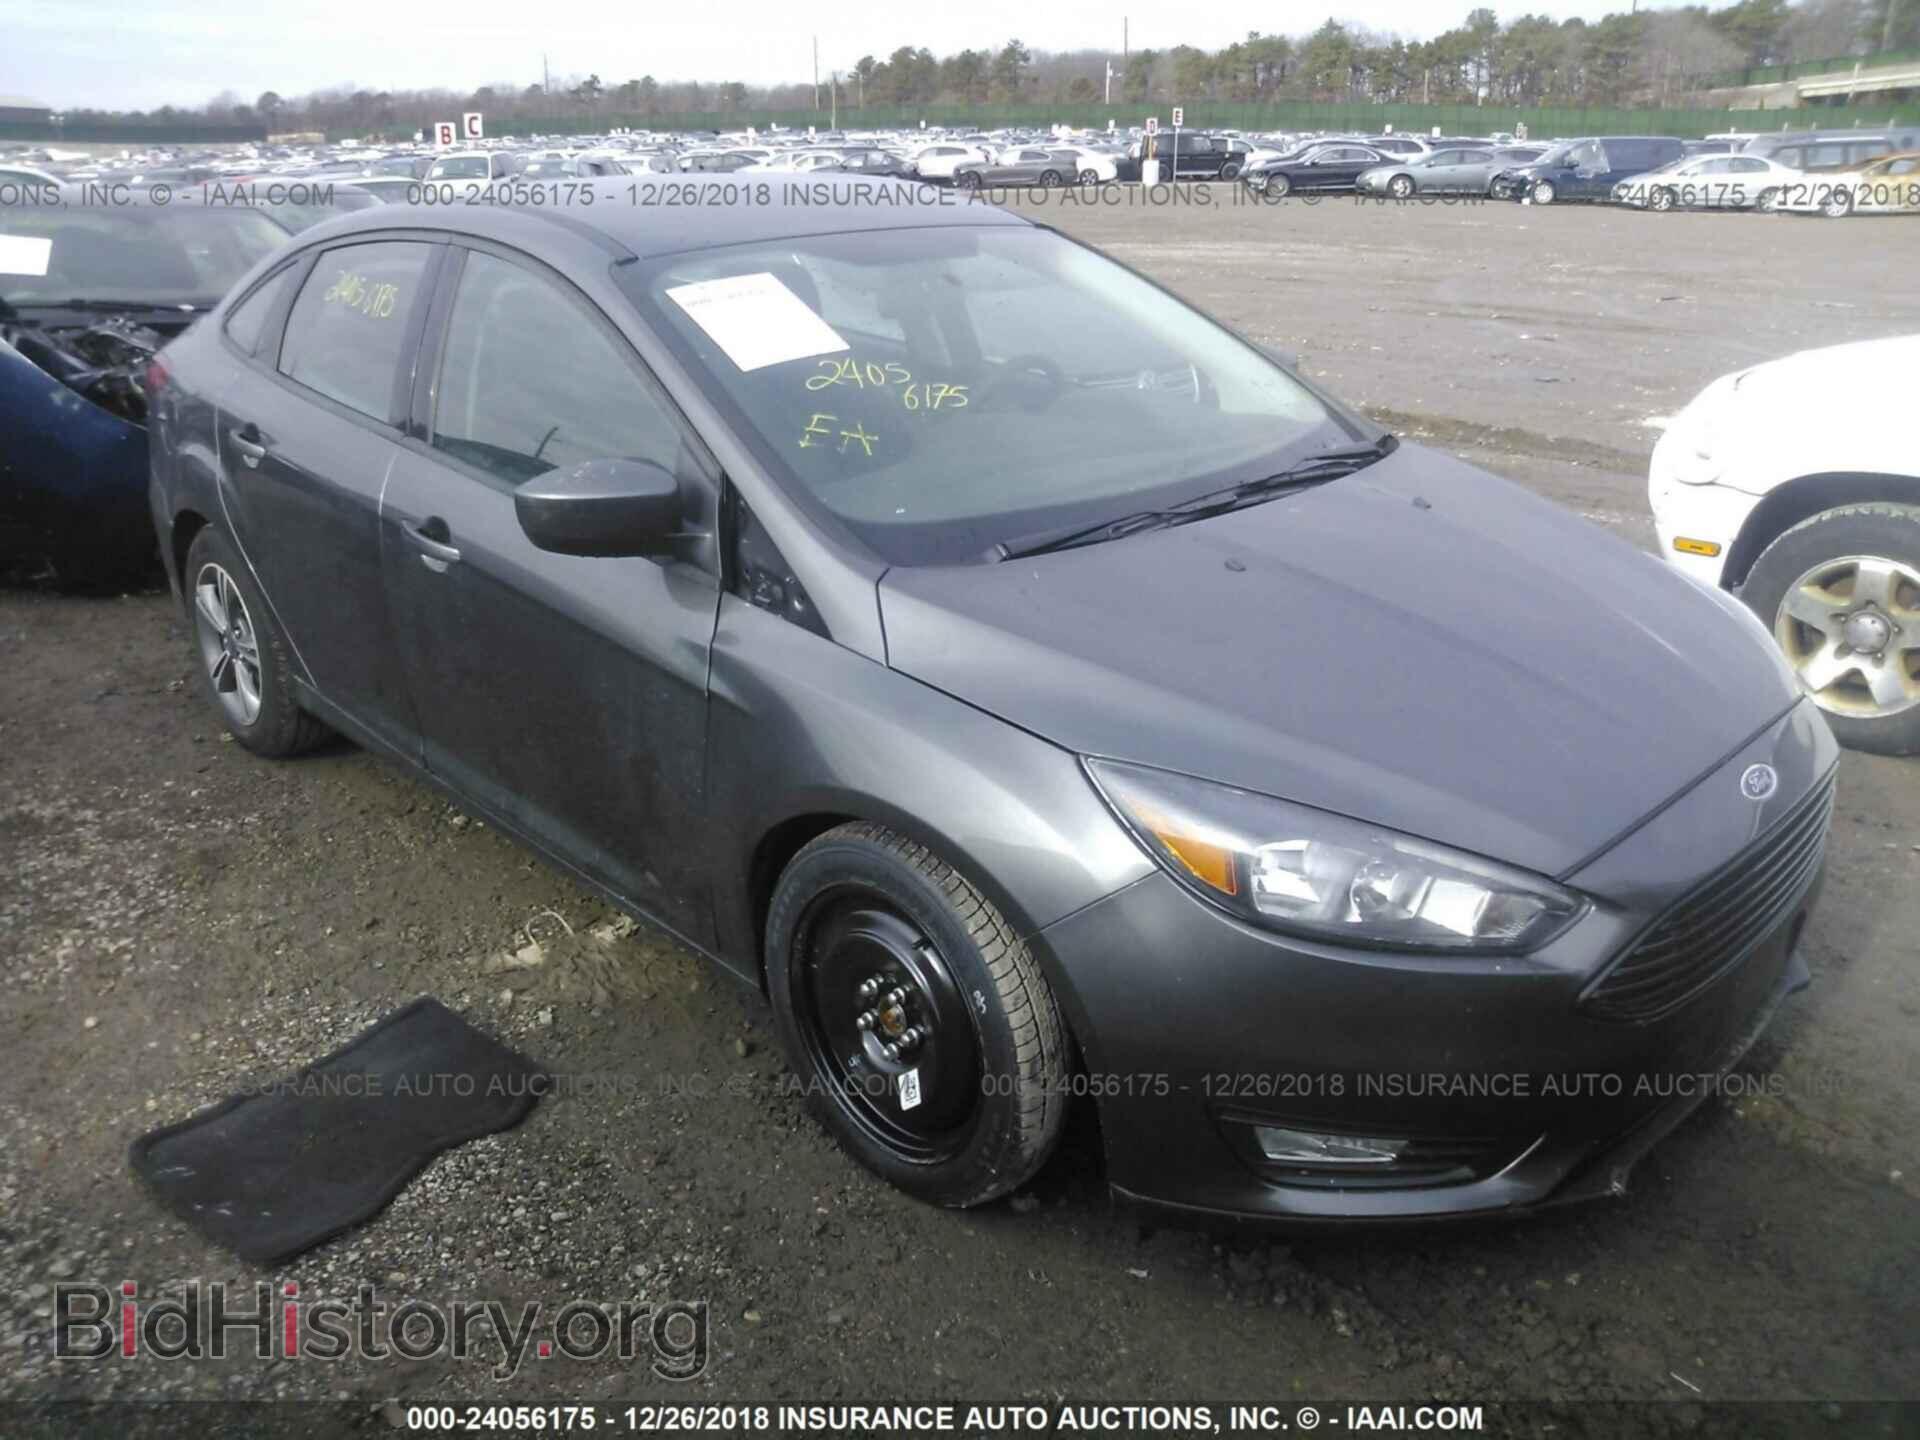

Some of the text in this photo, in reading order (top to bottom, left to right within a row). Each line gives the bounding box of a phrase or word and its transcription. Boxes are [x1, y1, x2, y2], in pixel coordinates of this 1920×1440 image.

[441, 125, 451, 145] B
[468, 116, 479, 136] C
[805, 357, 912, 391] 2405
[904, 383, 969, 410] 6175
